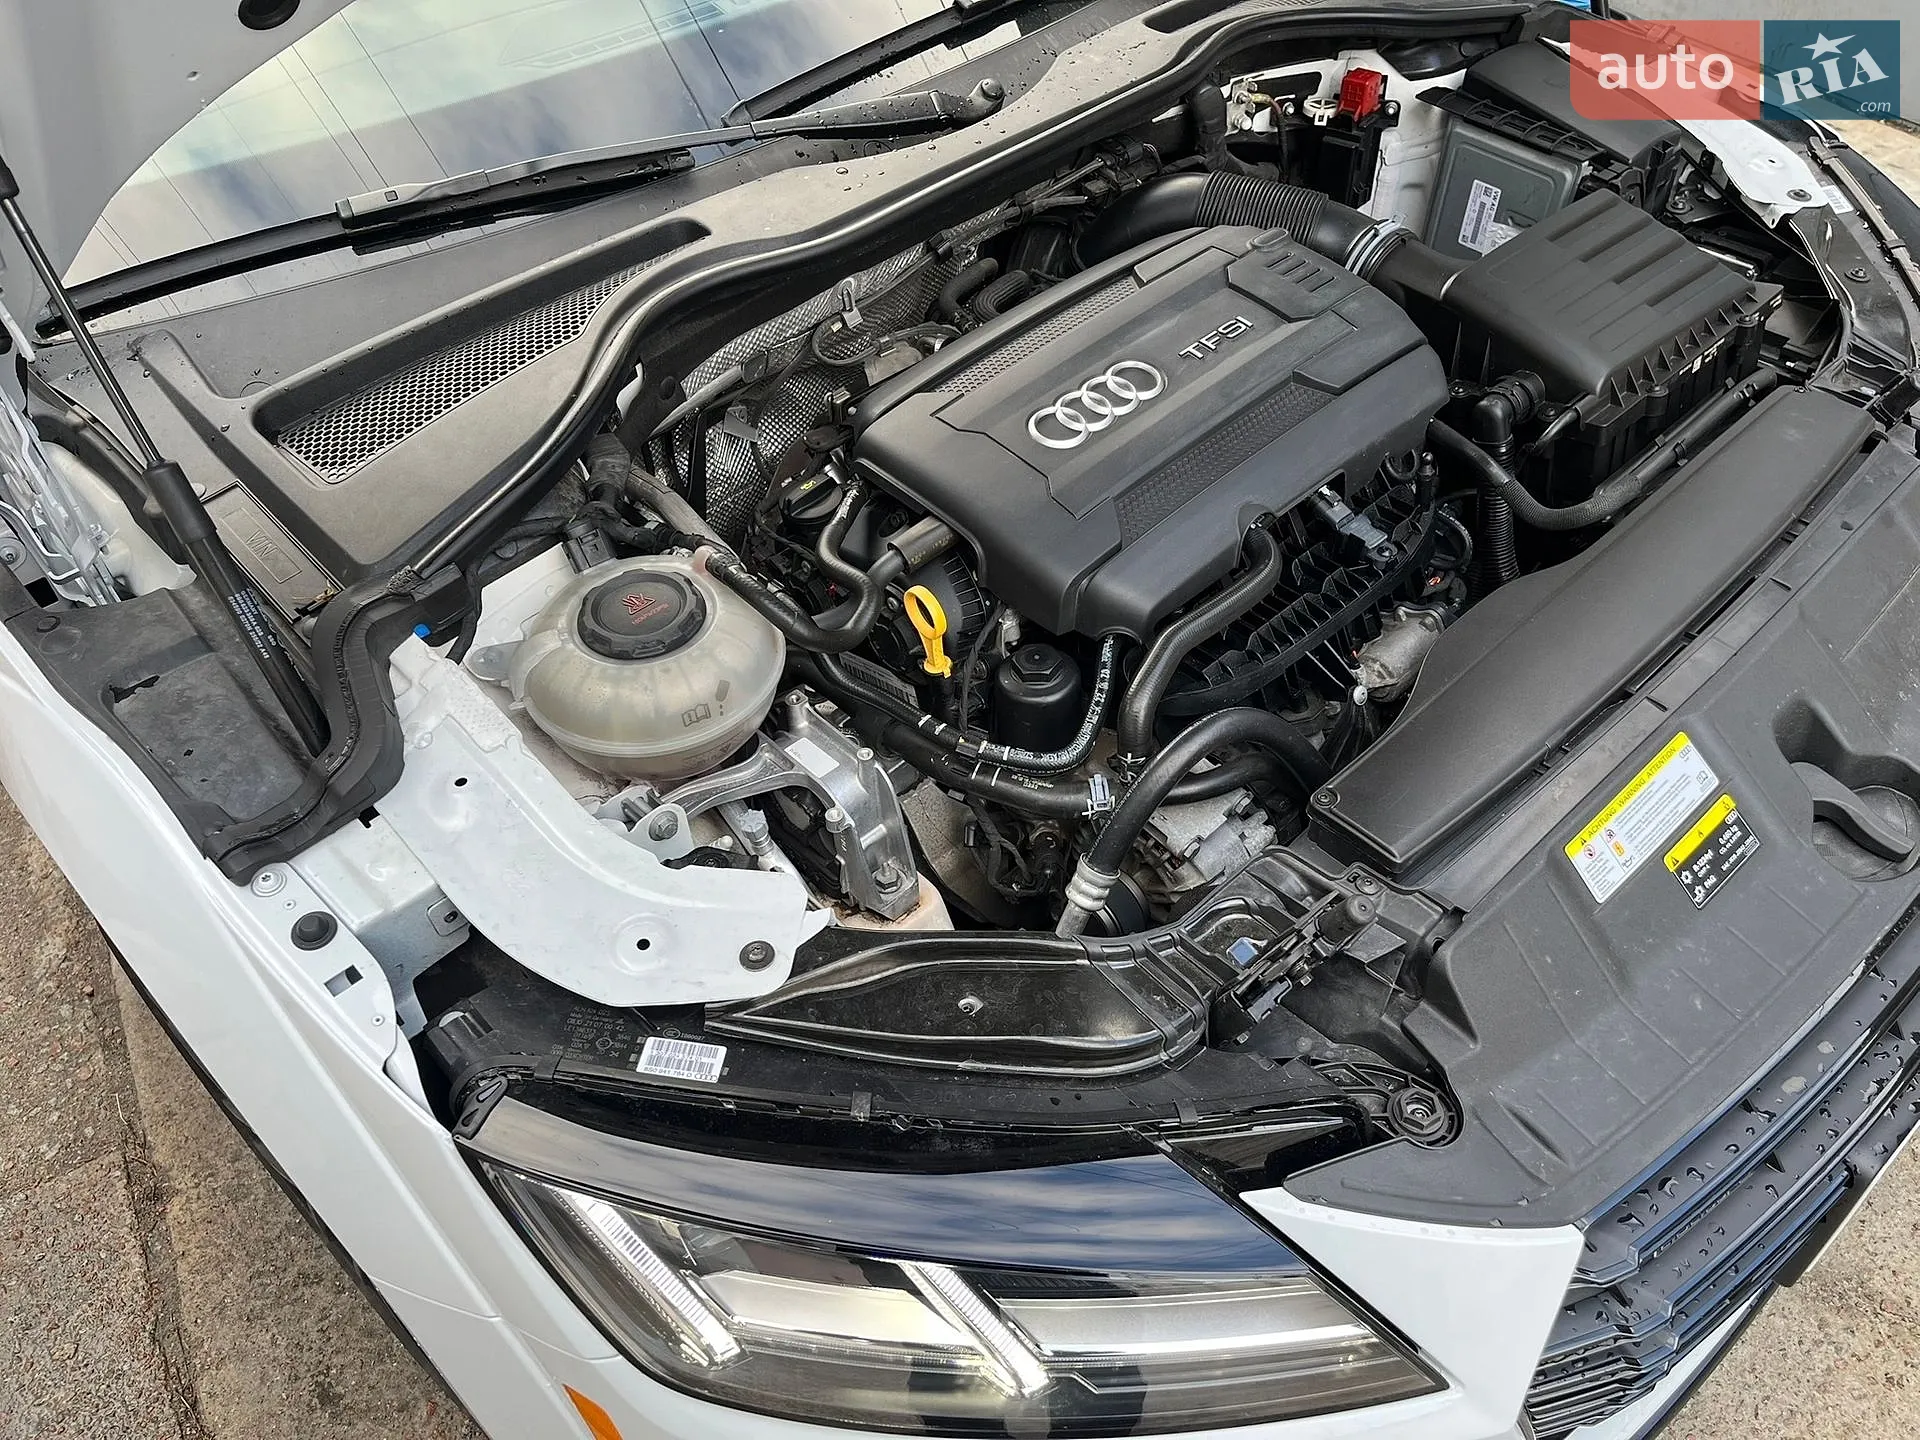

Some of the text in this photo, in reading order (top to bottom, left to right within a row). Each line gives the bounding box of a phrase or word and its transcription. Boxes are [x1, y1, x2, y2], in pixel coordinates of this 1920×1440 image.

[1178, 315, 1254, 360] TFSI
[246, 529, 278, 559] VIN
[1588, 807, 1617, 838] ACHTUNG
[1617, 779, 1646, 807] WARNING
[1646, 747, 1677, 779] ATTENTION
[1703, 874, 1717, 889] PAG
